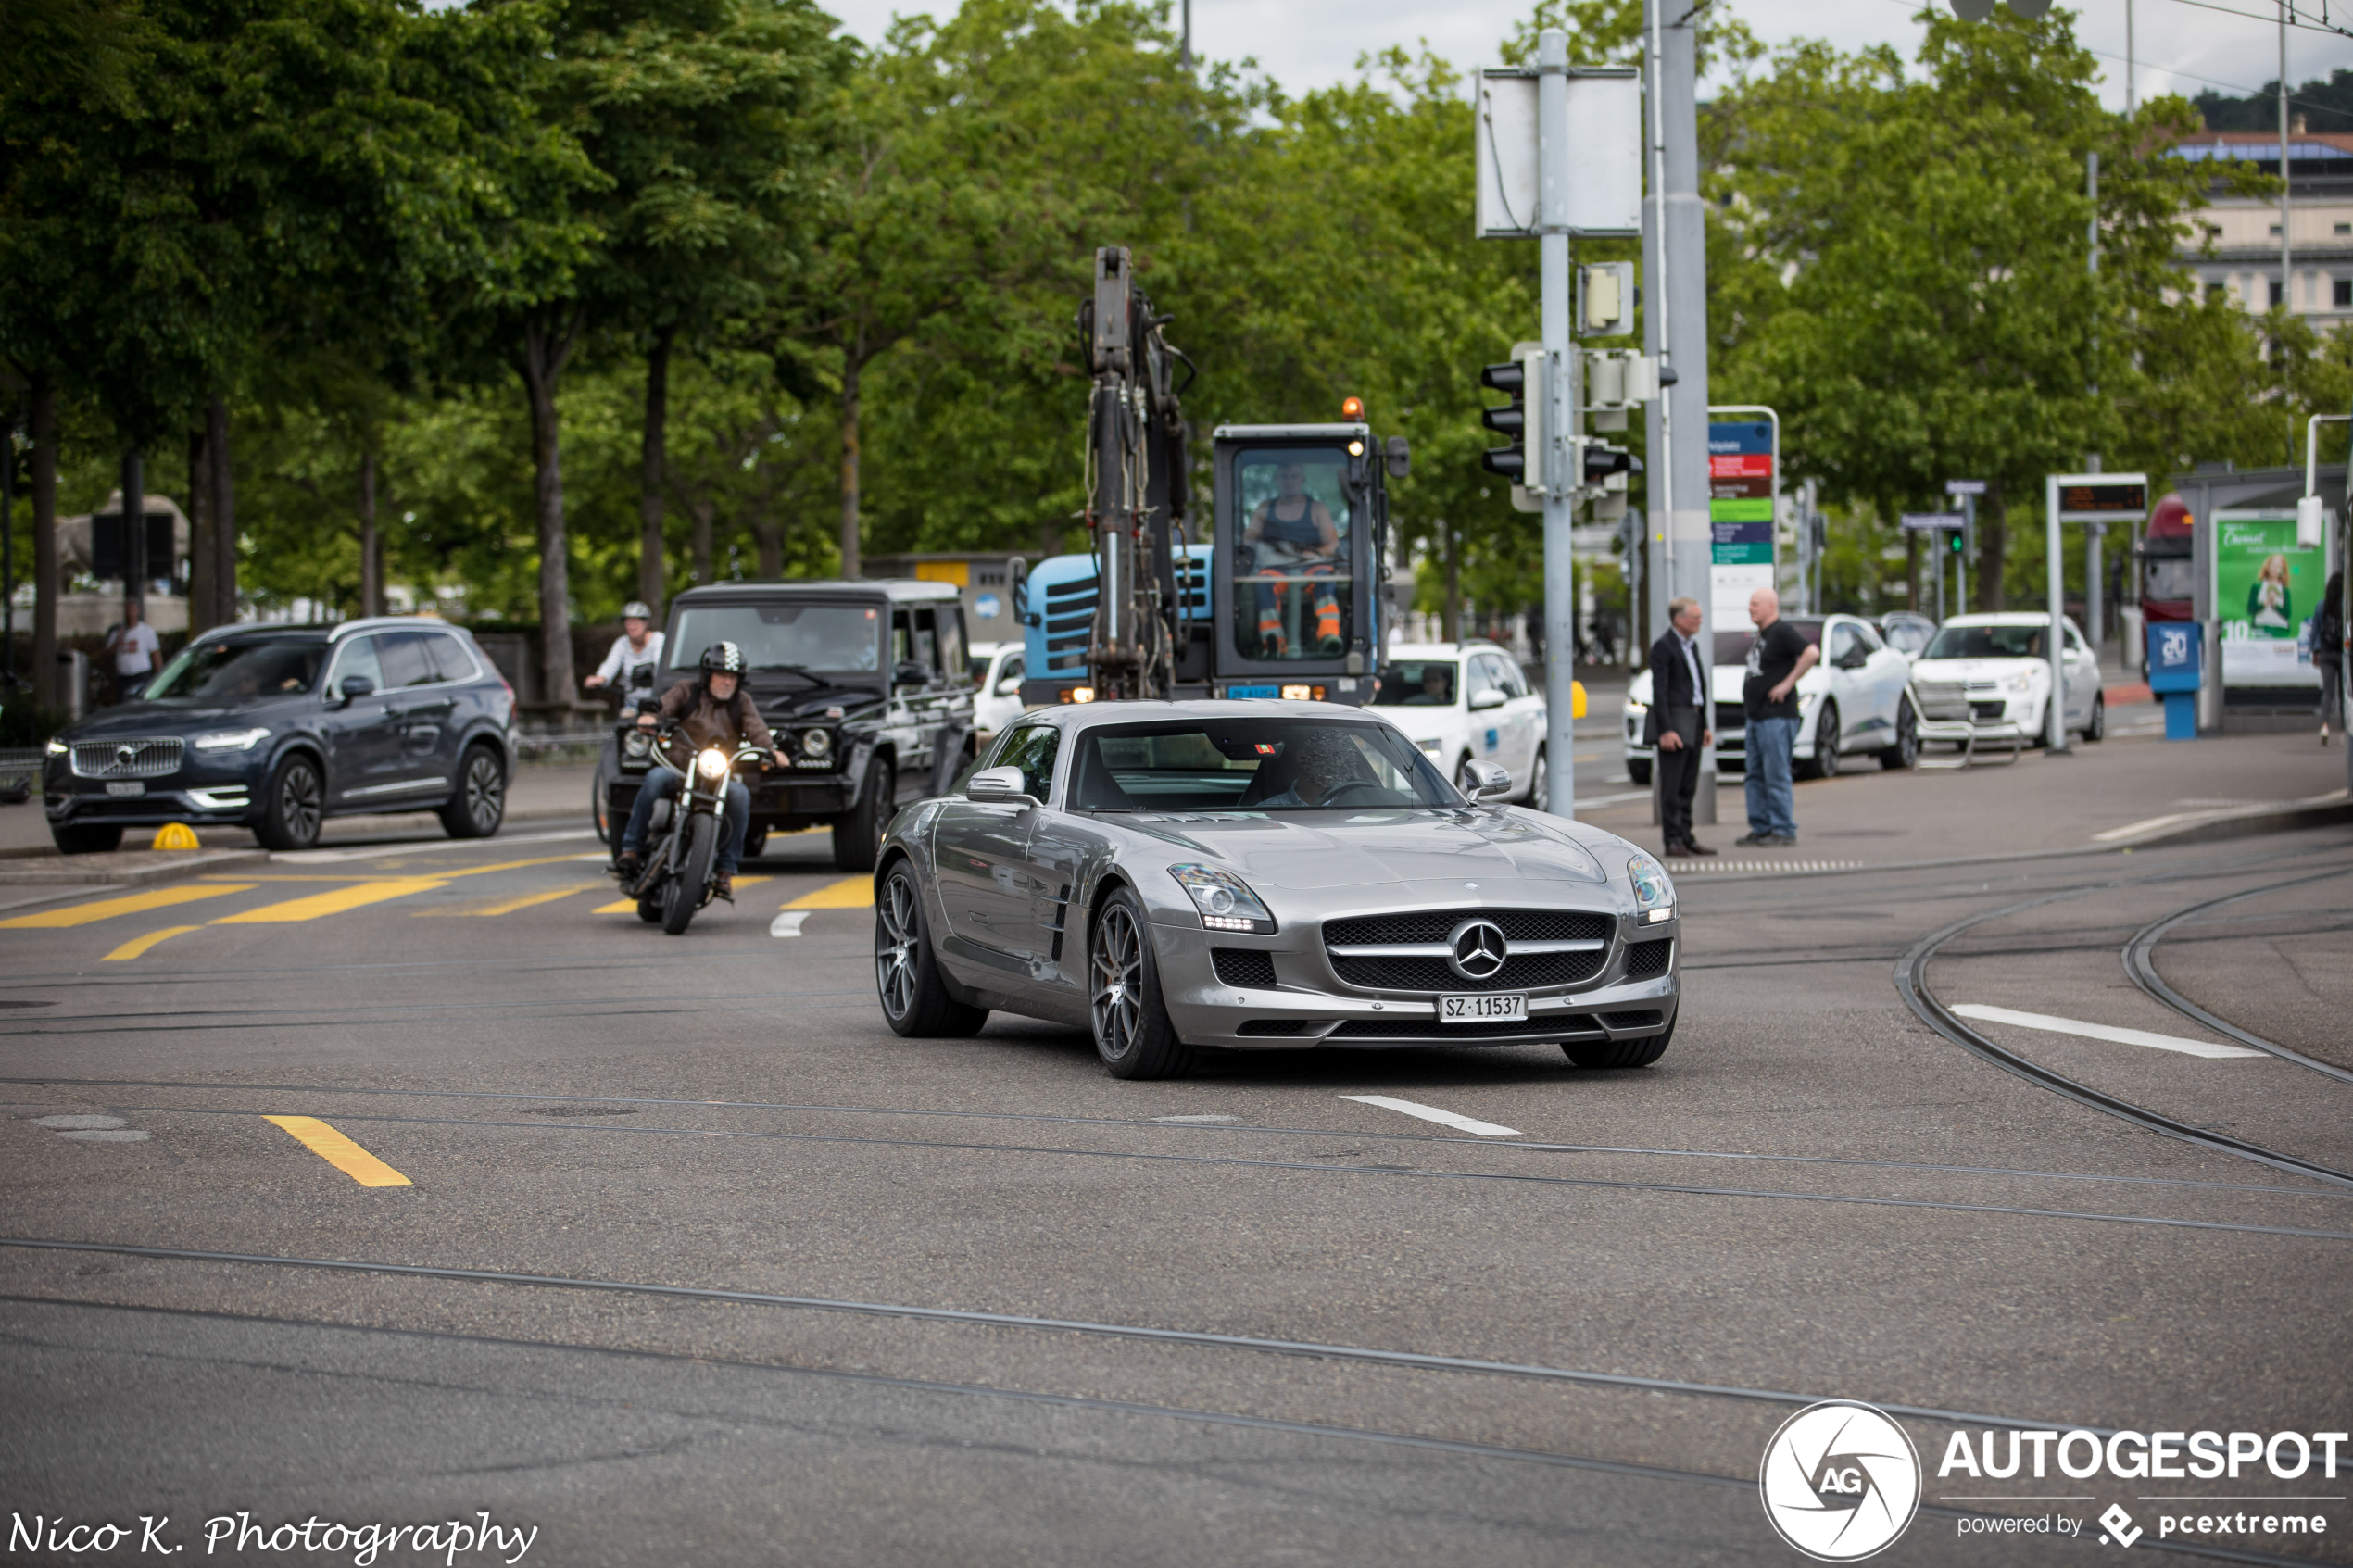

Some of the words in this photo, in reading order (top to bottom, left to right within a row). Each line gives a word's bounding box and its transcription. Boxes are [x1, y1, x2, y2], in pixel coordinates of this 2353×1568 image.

[2223, 619, 2249, 642] 10
[1446, 998, 1466, 1017] SZ
[1475, 997, 1521, 1016] 11537
